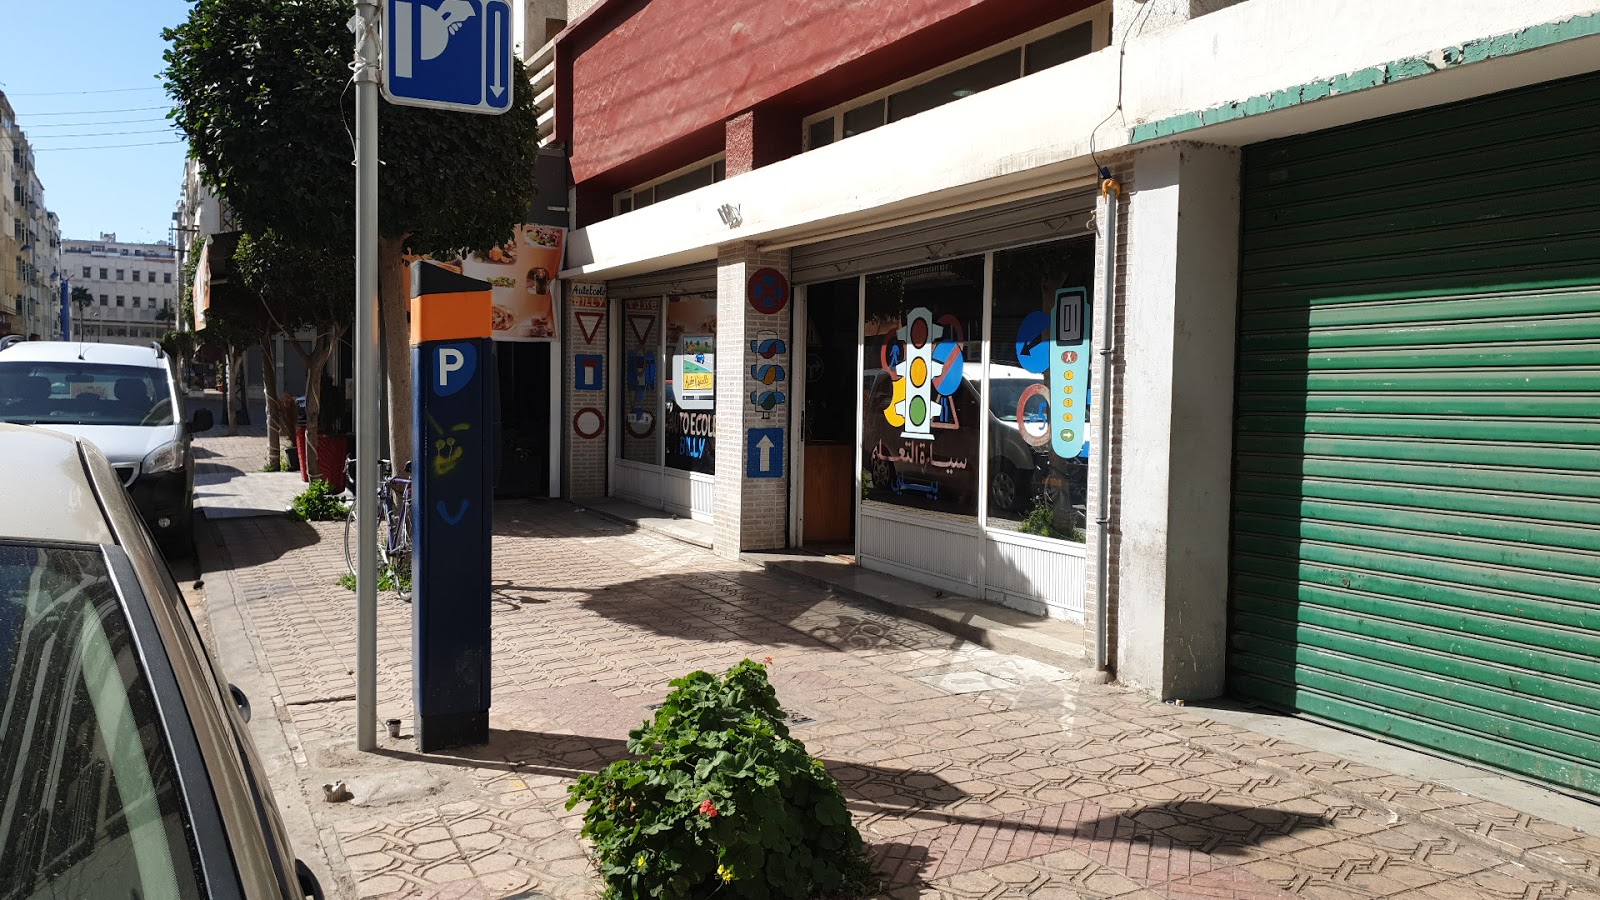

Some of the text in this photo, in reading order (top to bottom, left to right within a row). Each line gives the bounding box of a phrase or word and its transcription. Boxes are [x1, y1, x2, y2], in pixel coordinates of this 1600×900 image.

[574, 297, 605, 307] BILLY
[439, 348, 464, 386] P
[680, 436, 706, 459] BILLY
